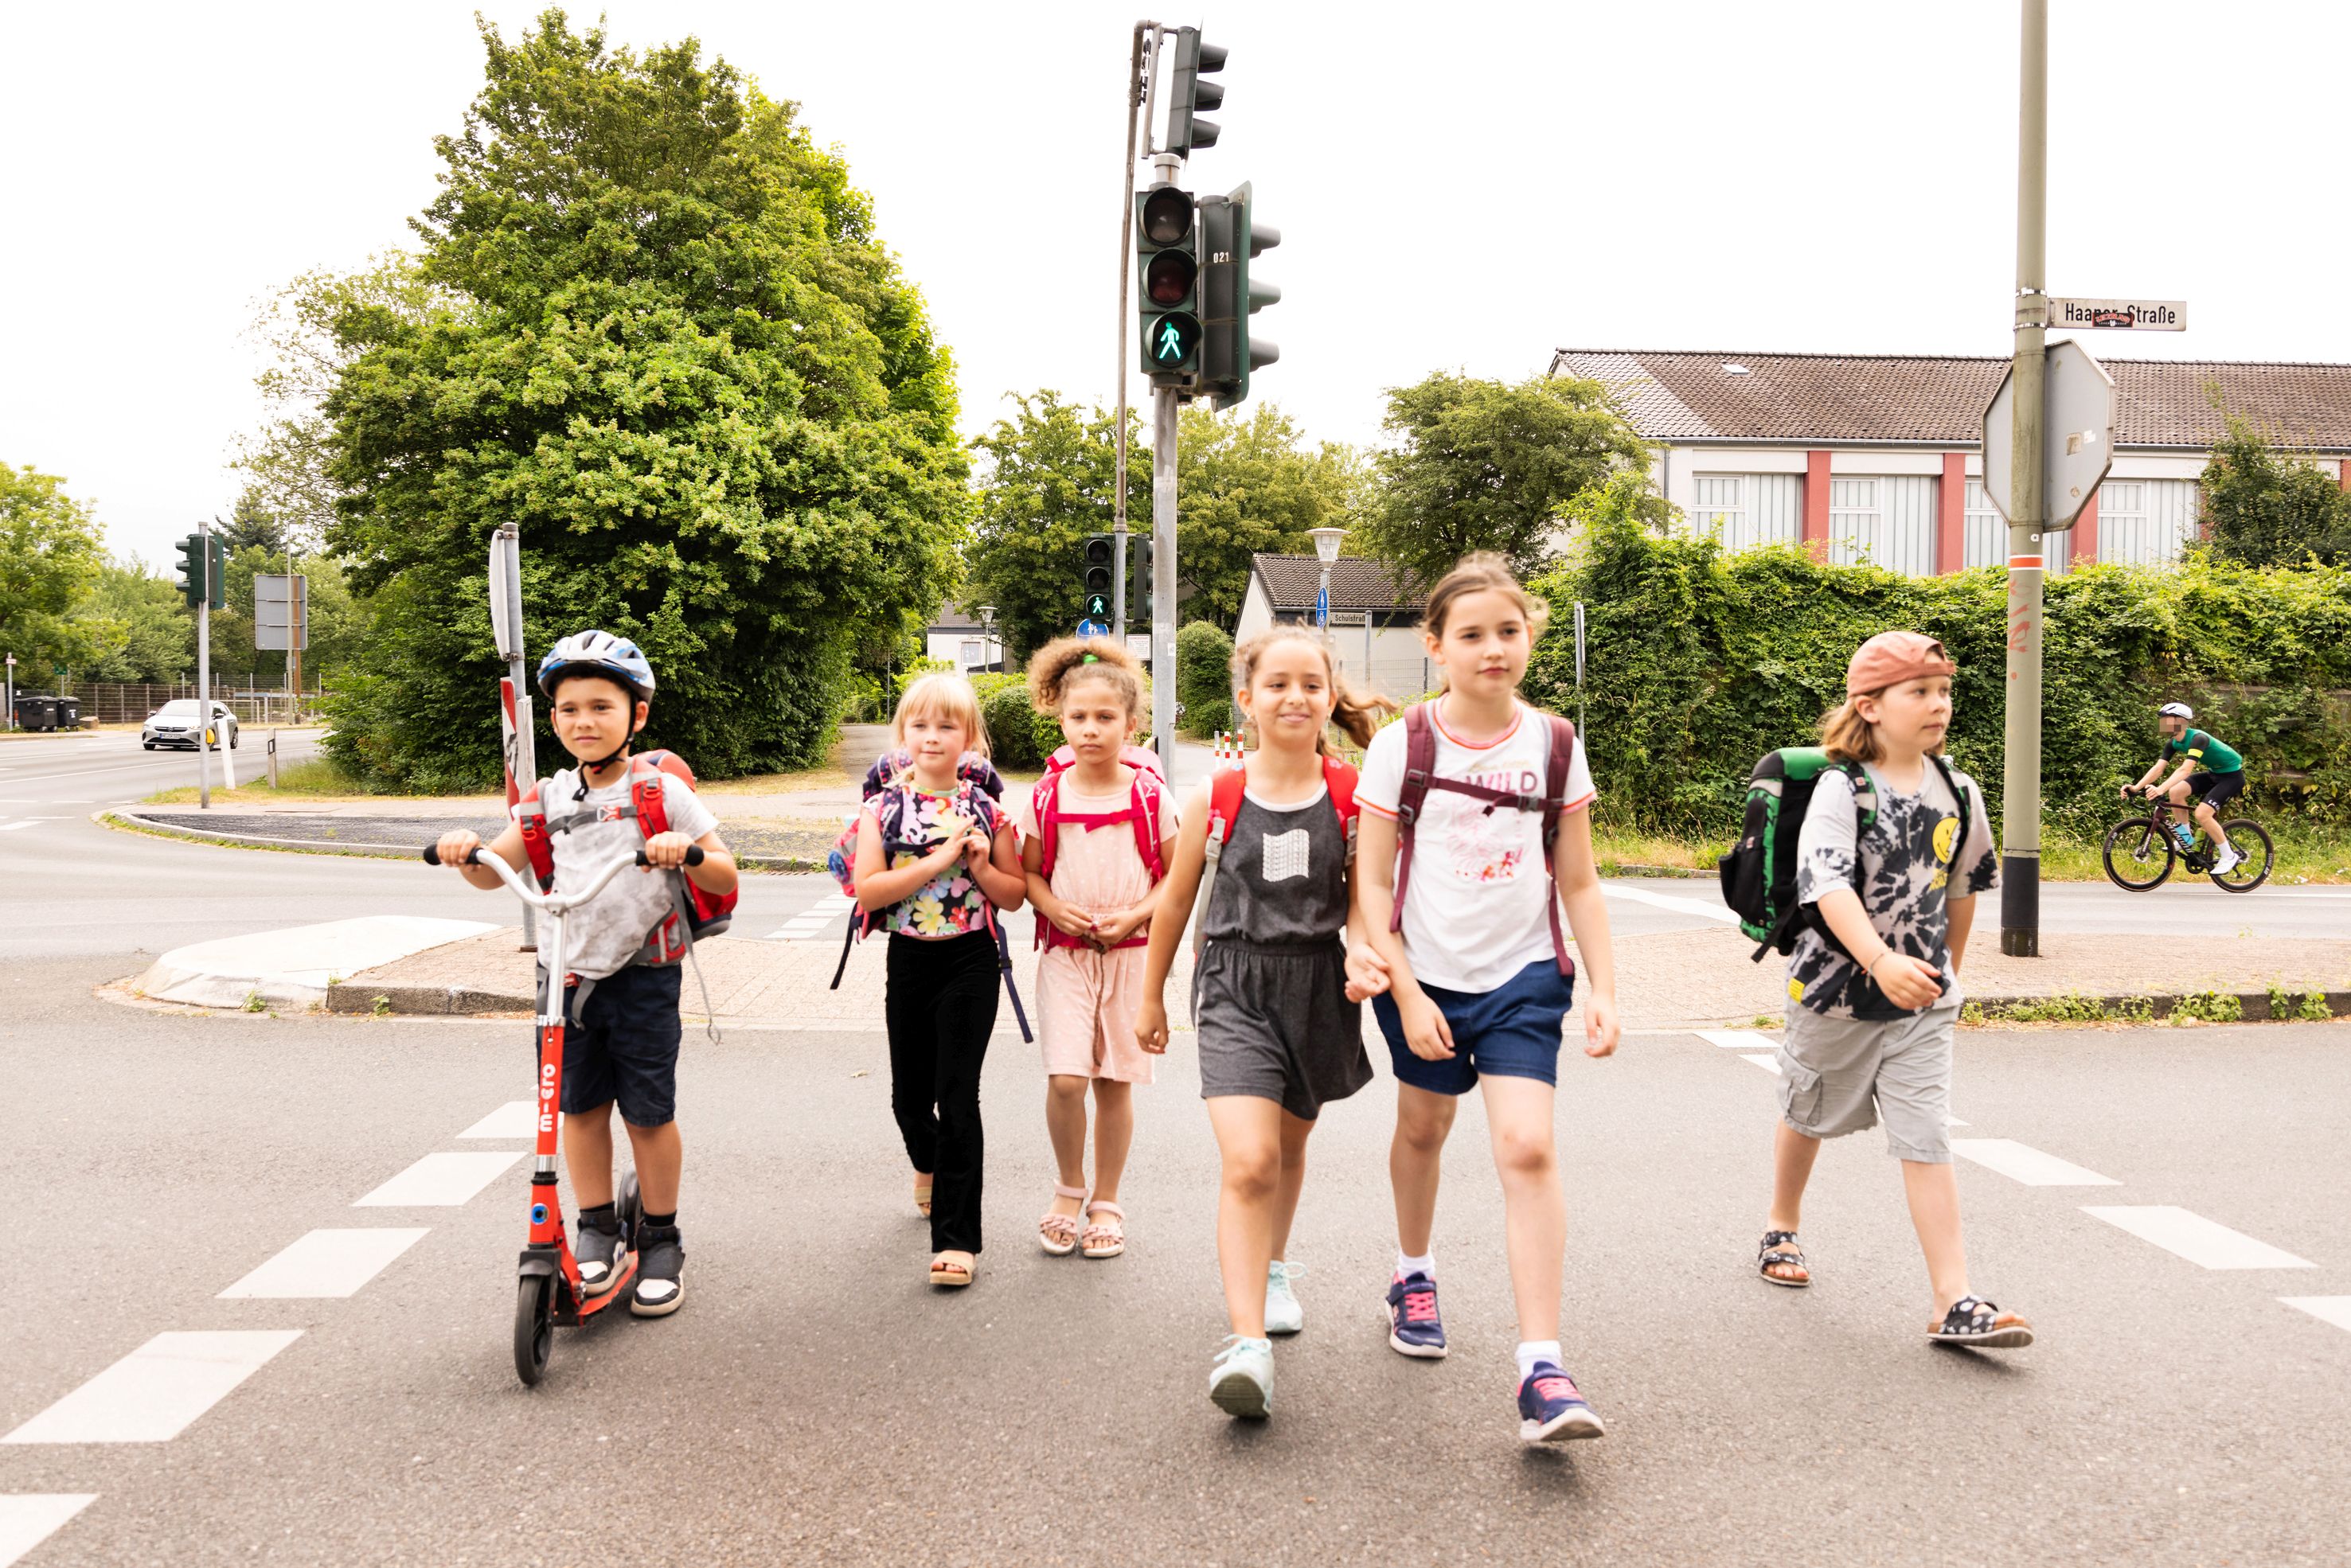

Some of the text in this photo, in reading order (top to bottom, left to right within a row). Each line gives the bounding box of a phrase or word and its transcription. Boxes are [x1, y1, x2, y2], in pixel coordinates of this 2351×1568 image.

[1213, 252, 1229, 263] 021
[2127, 305, 2175, 324] Straße
[1466, 770, 1537, 795] WILD
[539, 1063, 557, 1132] micro
